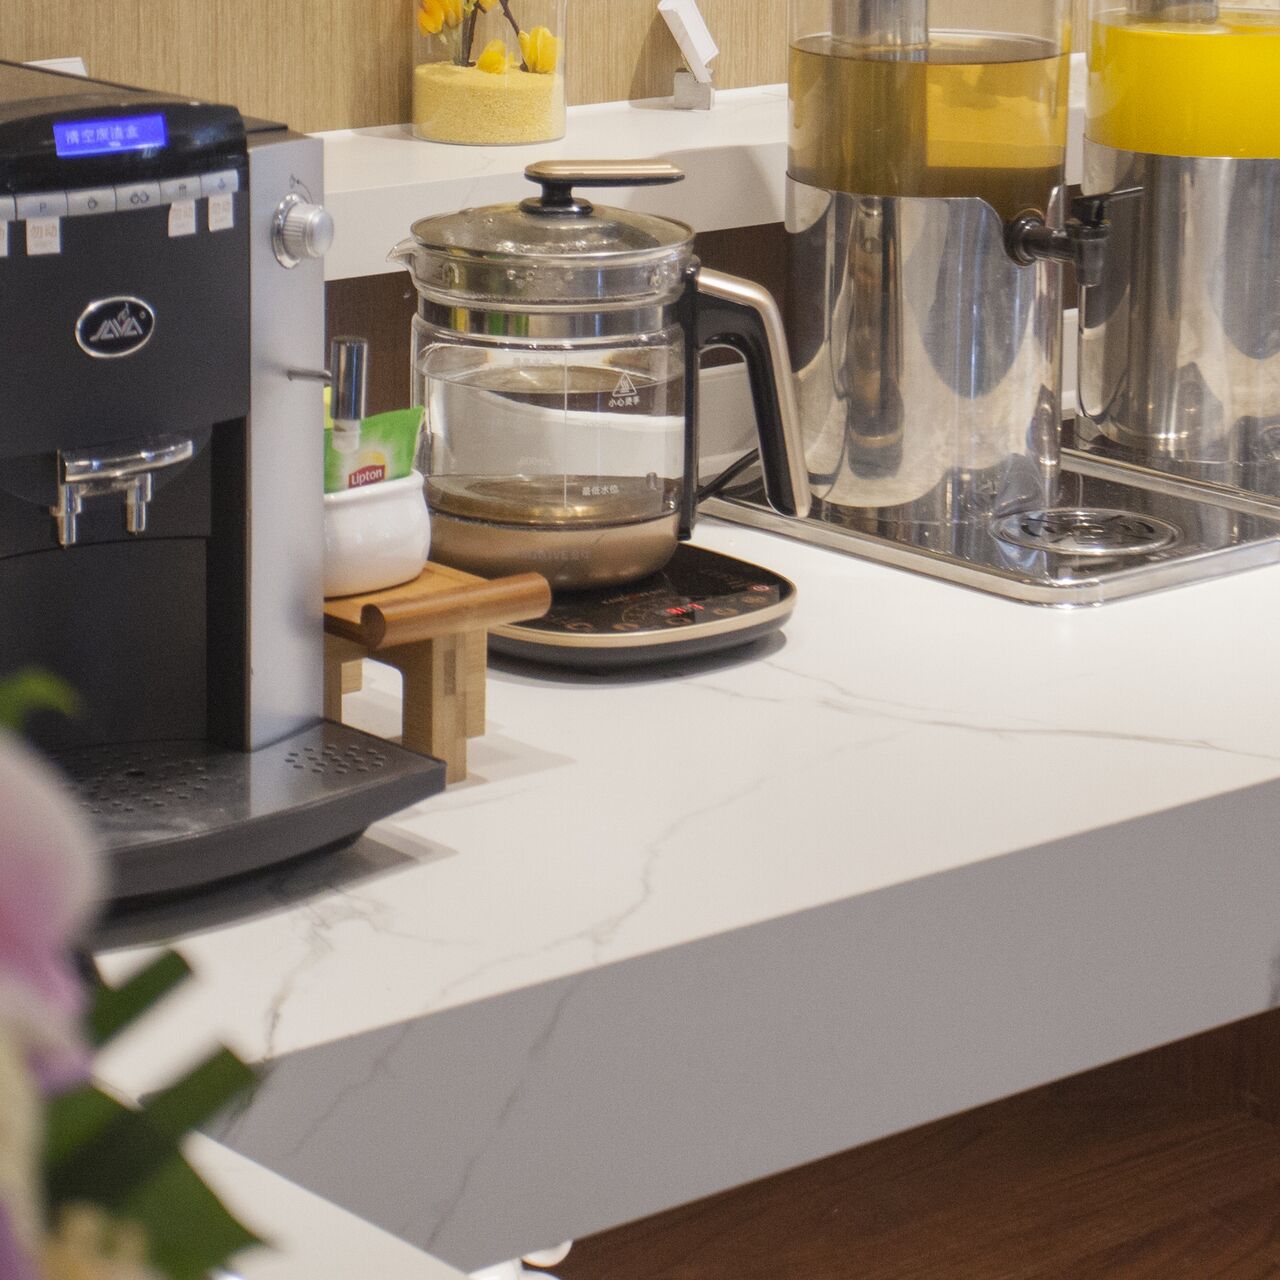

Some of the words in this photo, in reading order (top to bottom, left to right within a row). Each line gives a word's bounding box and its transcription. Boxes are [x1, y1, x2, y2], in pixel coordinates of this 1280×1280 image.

[39, 202, 47, 213] P
[31, 223, 57, 238] 勿动
[89, 316, 143, 342] JAVA
[351, 468, 383, 486] Lipton
[581, 484, 619, 497] 最低水位
